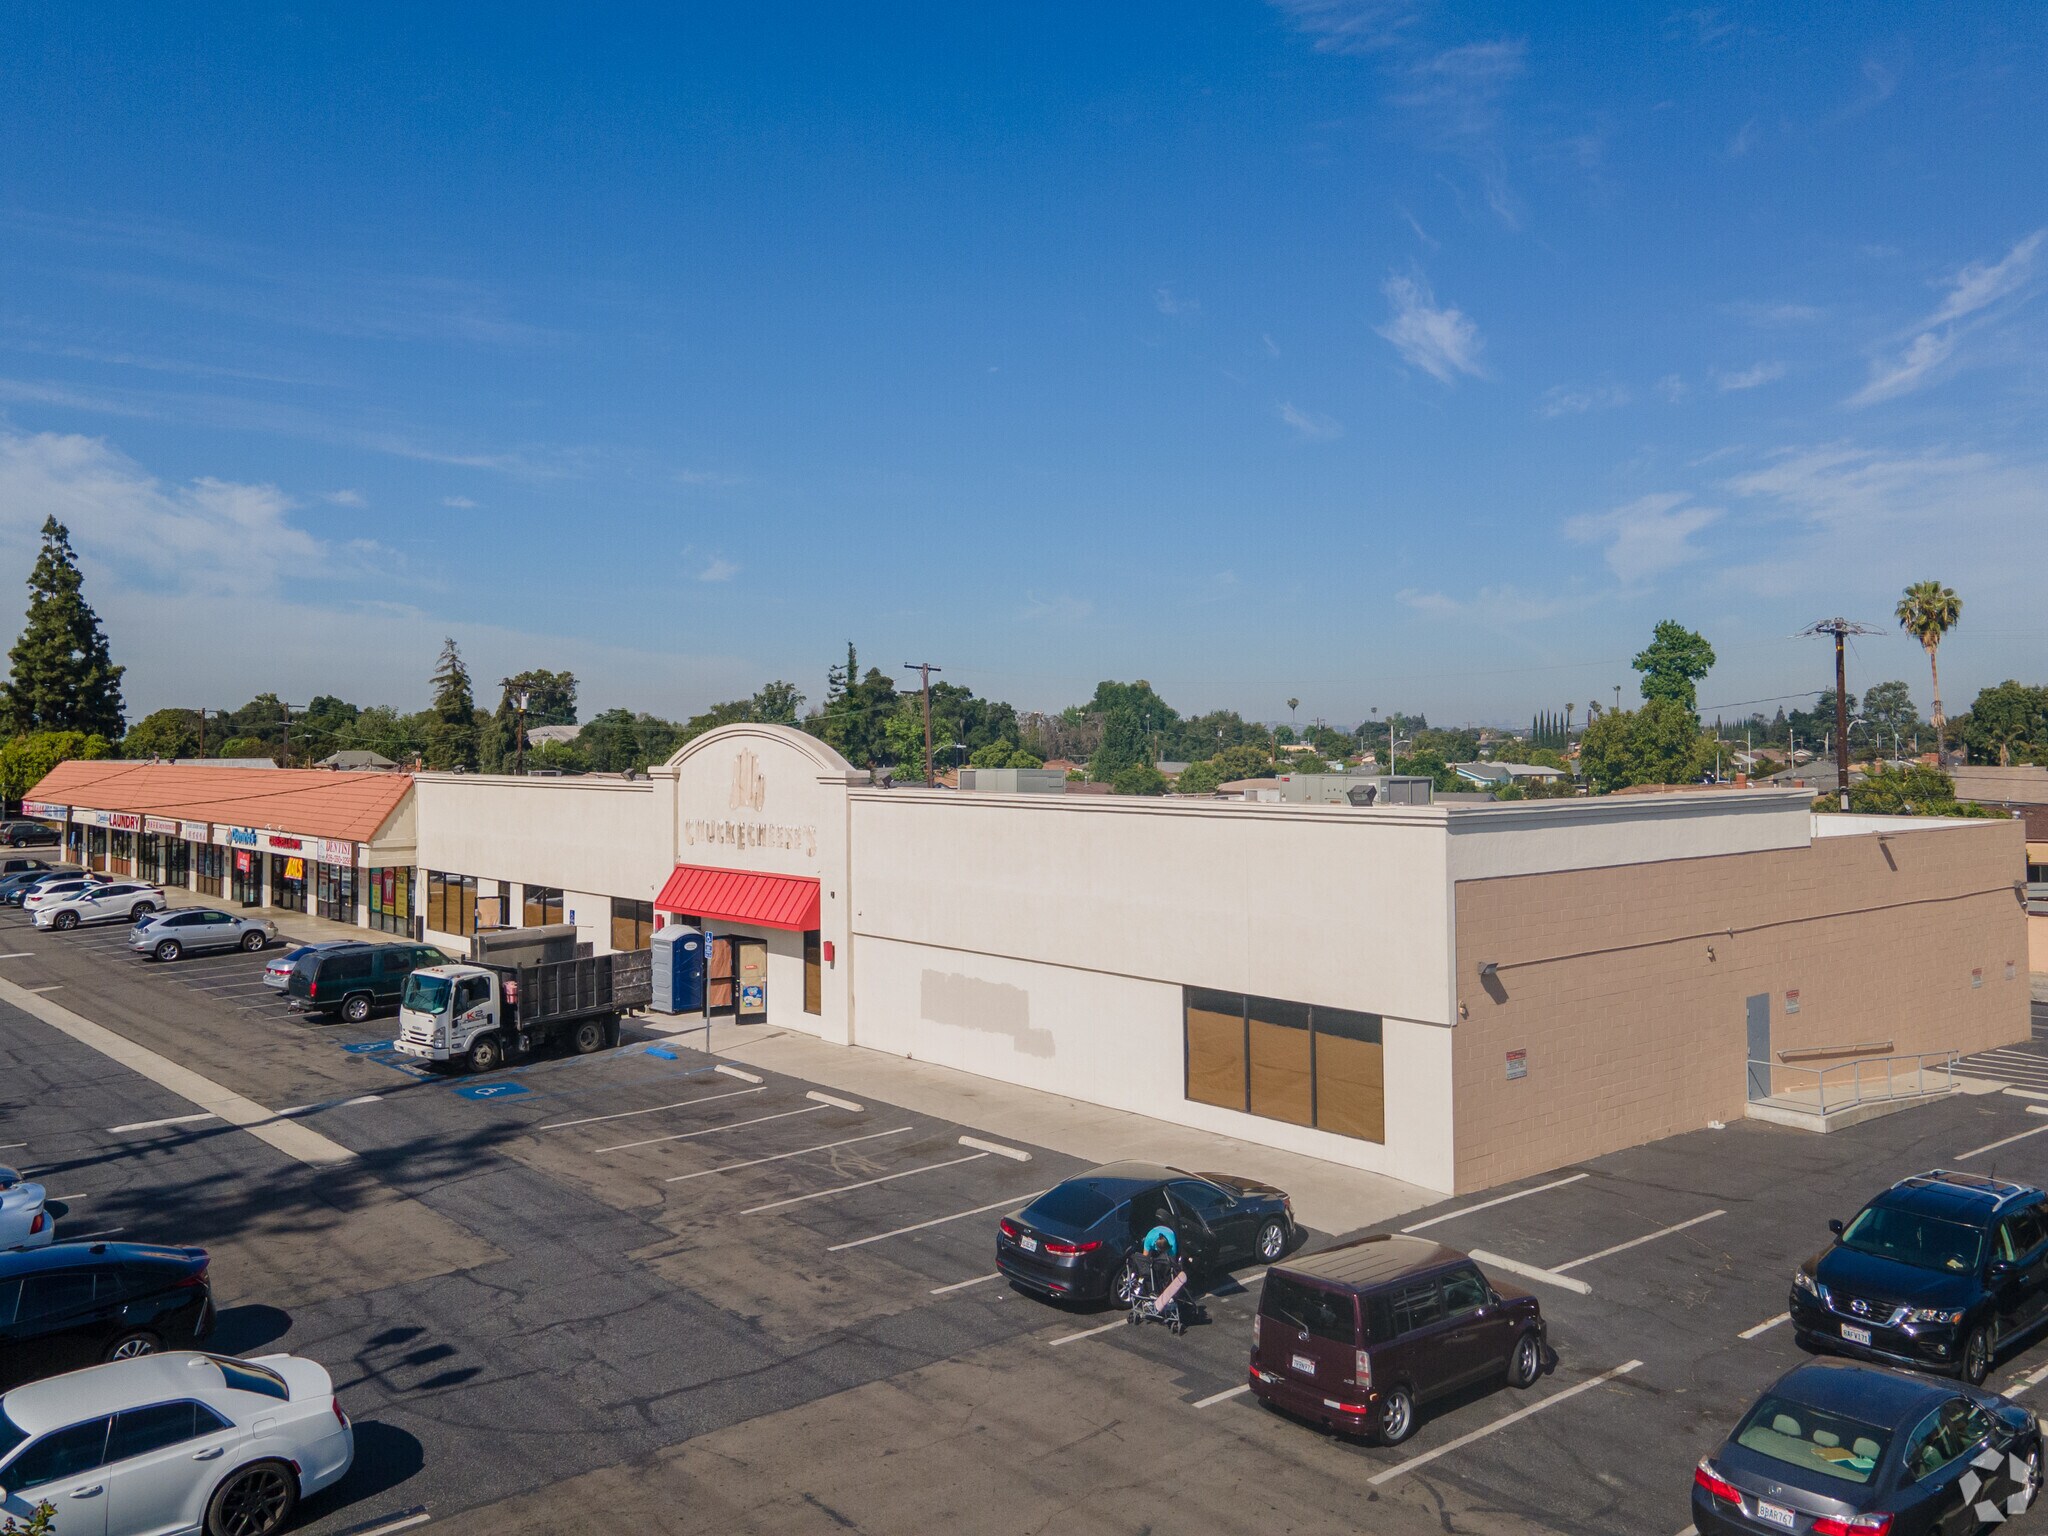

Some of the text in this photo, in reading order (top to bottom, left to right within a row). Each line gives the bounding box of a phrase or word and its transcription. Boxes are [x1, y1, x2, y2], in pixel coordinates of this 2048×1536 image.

[109, 813, 139, 830] LAUNDRY
[326, 840, 351, 855] DENTIST
[1760, 1505, 1792, 1525] 8BAR767
